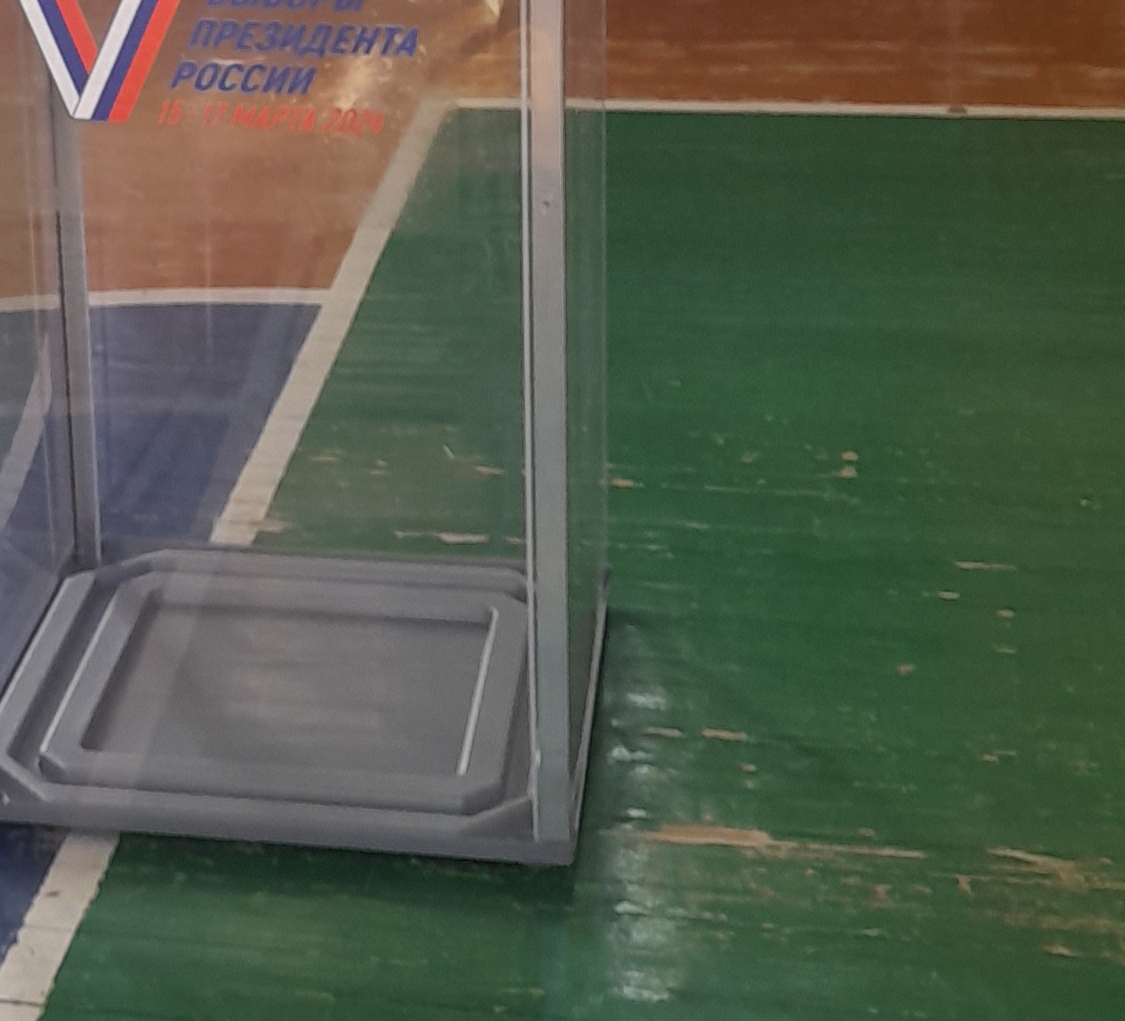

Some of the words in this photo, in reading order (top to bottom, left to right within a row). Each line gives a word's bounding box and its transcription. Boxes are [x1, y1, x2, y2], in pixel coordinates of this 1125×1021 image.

[189, 18, 419, 58] ПРЕЗИДЕНТА
[171, 60, 316, 96] РОССИИ
[231, 103, 316, 131] МАРТА
